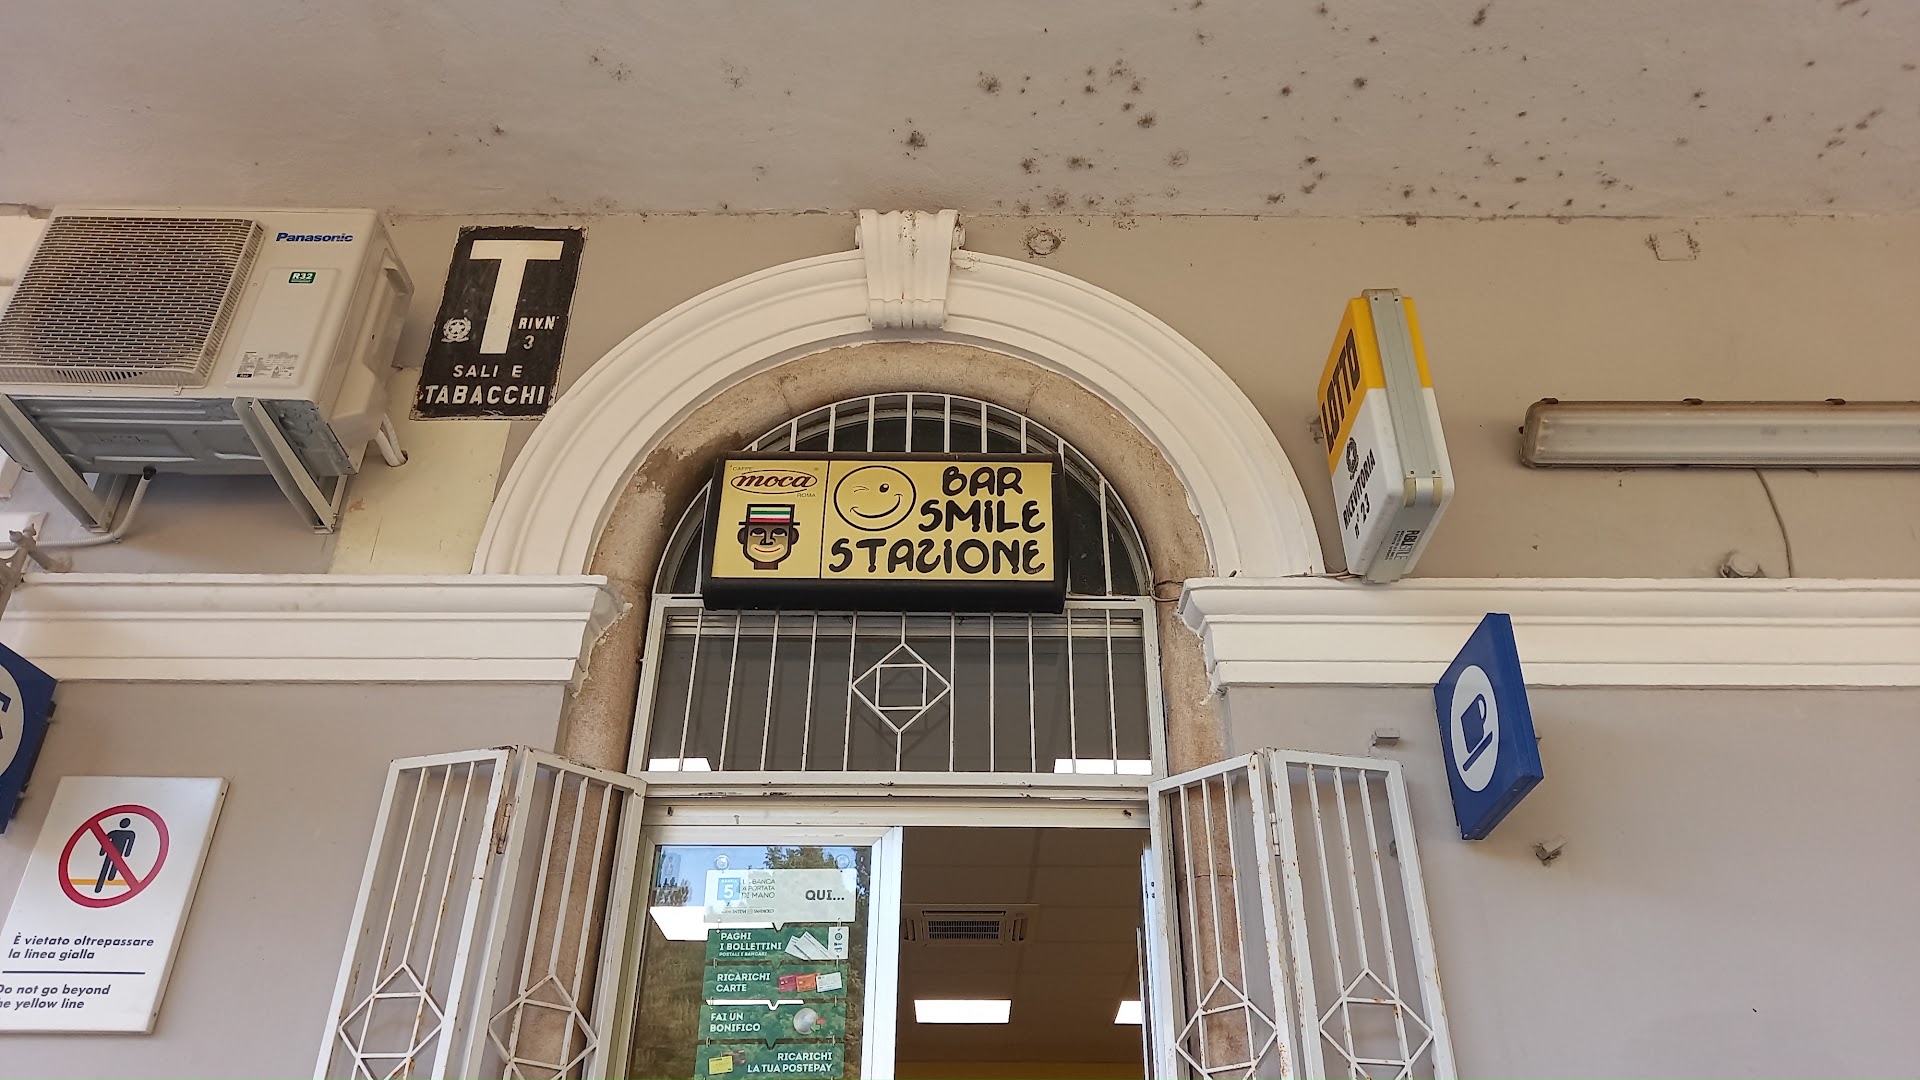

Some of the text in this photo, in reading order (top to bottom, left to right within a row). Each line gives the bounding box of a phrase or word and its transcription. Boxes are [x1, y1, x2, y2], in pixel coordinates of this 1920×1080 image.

[276, 232, 353, 242] Panasonic
[292, 272, 313, 280] R32
[470, 240, 564, 354] T
[523, 335, 535, 350] 3
[452, 364, 523, 378] SALI E
[425, 385, 545, 405] TABACCHI
[1320, 328, 1361, 455] LOTTO
[736, 475, 812, 488] moca
[942, 465, 1024, 496] BAR
[1360, 493, 1371, 524] 23
[918, 499, 1046, 533] SMILE
[828, 537, 1046, 575] STAZIONE
[723, 884, 734, 899] 5
[805, 889, 845, 901] QUI...
[13, 932, 154, 948] È vietato oltrepassare
[720, 932, 752, 941] PAGHI
[719, 942, 783, 951] I BOLLETTINI
[8, 949, 95, 961] la linea gialla
[716, 972, 771, 982] RICARICHI
[16, 985, 39, 995] not
[41, 986, 59, 997] go
[62, 984, 111, 997] beyond
[715, 983, 747, 993] CARTE
[14, 998, 58, 1011] yellow
[60, 998, 85, 1009] line
[710, 1012, 744, 1021] FAI UN
[709, 1022, 761, 1033] BONIFICO
[777, 1052, 833, 1061] RICARICHI
[747, 1062, 833, 1073] LA TUA POSTEPAY
